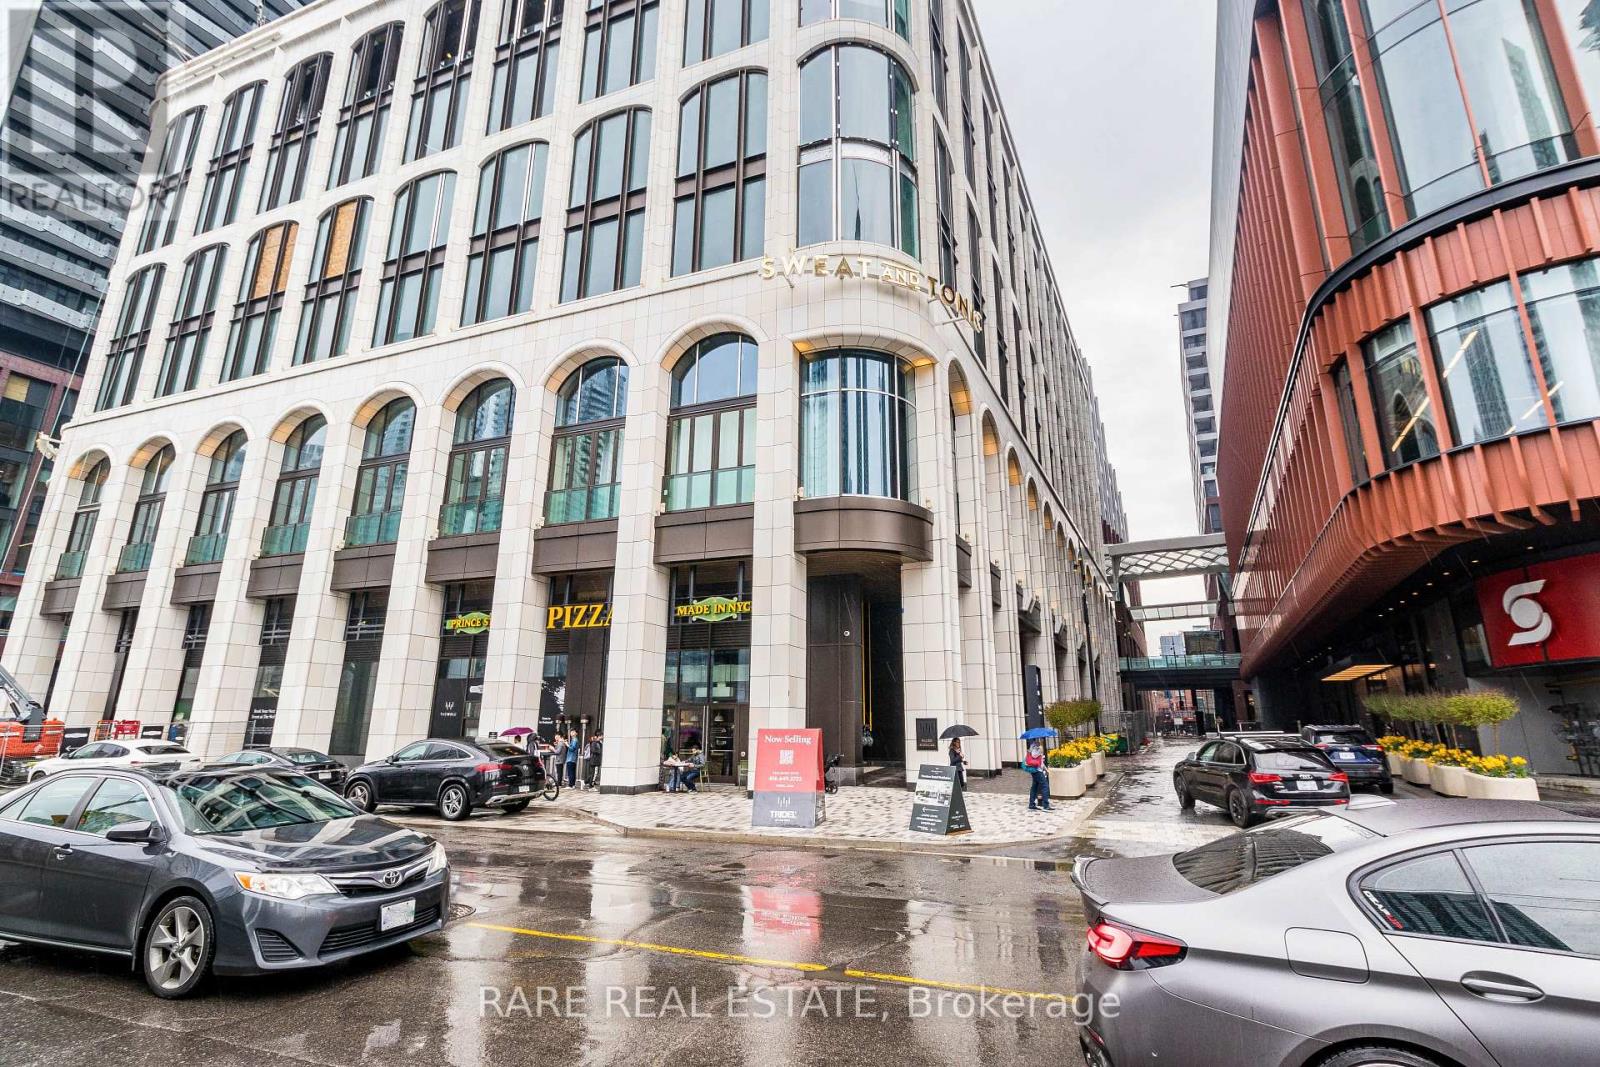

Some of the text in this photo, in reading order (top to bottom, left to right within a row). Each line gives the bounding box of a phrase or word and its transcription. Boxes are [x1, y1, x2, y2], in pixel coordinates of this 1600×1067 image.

[761, 254, 983, 333] SWEAT AND TONIC
[677, 601, 751, 616] MADE IN NYC
[451, 618, 481, 628] PRINCE
[764, 734, 812, 746] Now Selling
